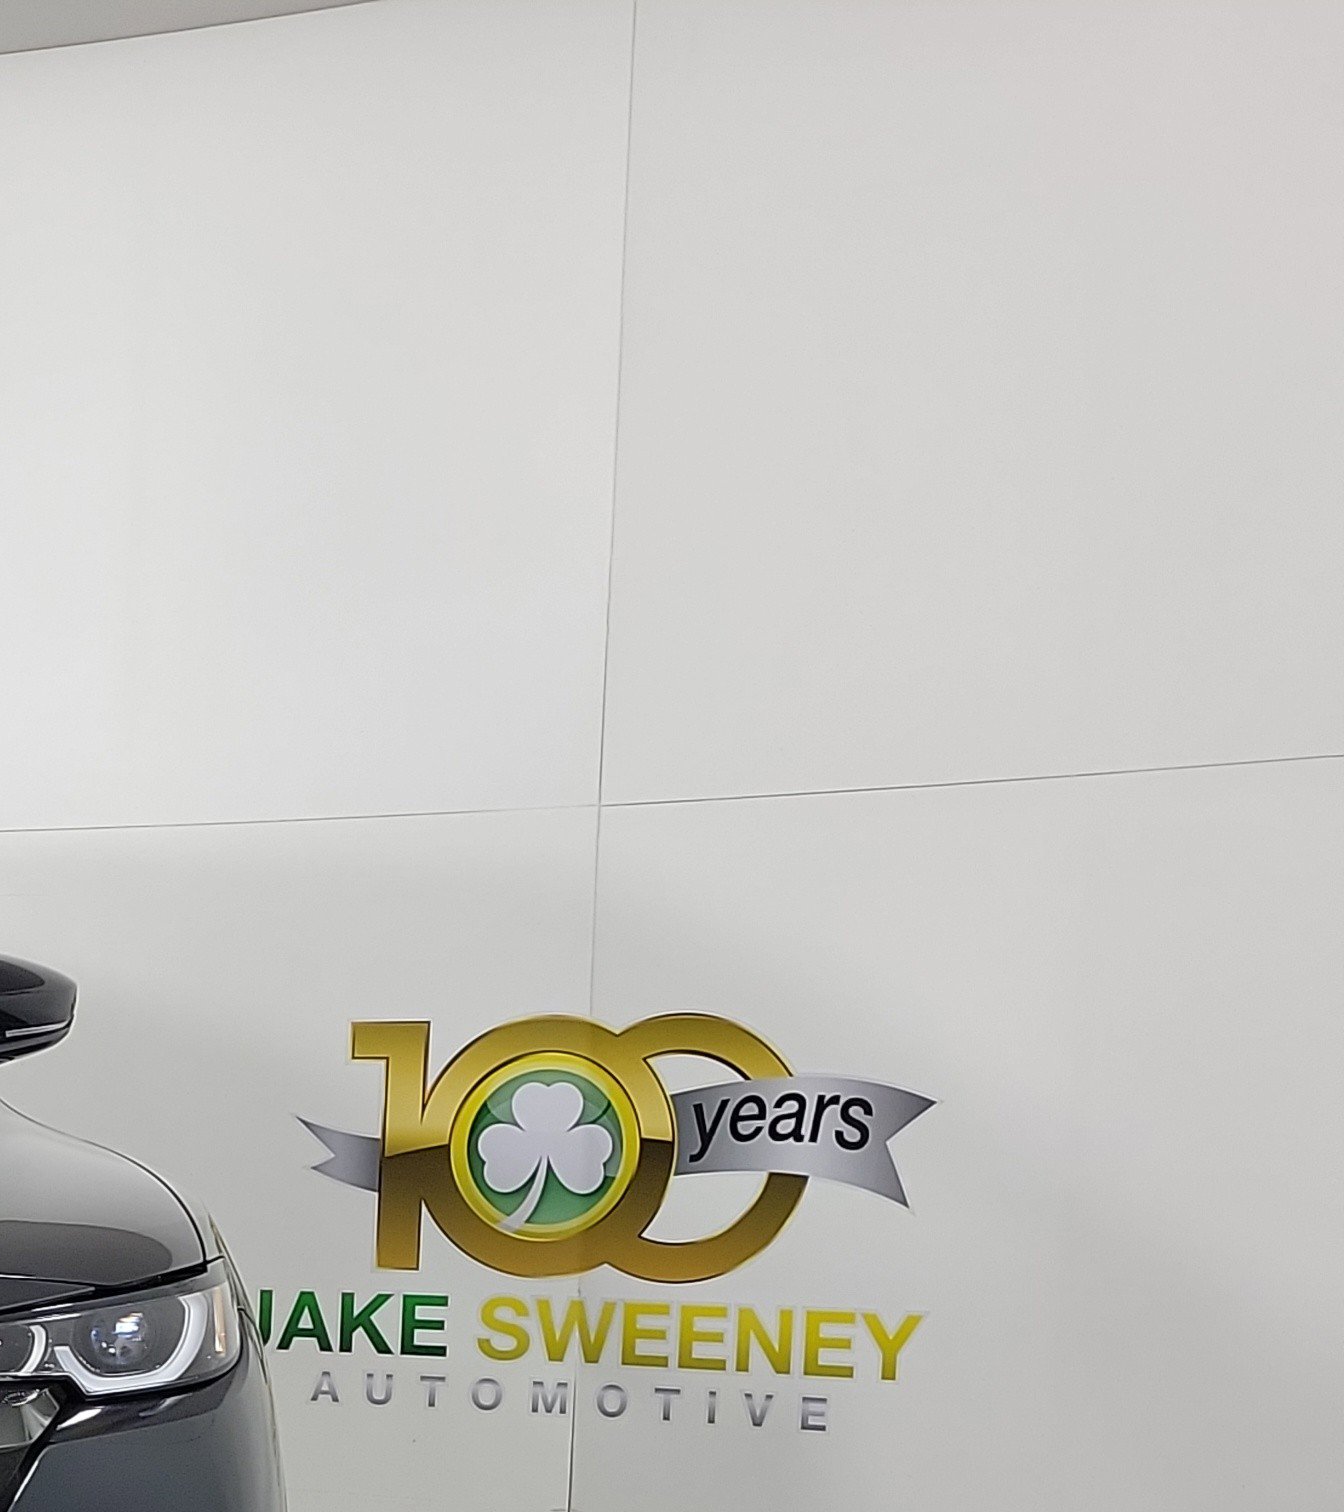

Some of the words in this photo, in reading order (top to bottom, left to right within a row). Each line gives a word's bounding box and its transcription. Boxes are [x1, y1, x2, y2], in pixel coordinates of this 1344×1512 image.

[352, 1014, 810, 1282] 100
[689, 1093, 874, 1163] years
[476, 1297, 924, 1381] SWEENEY
[311, 1371, 828, 1431] AUTOMOTIVE
